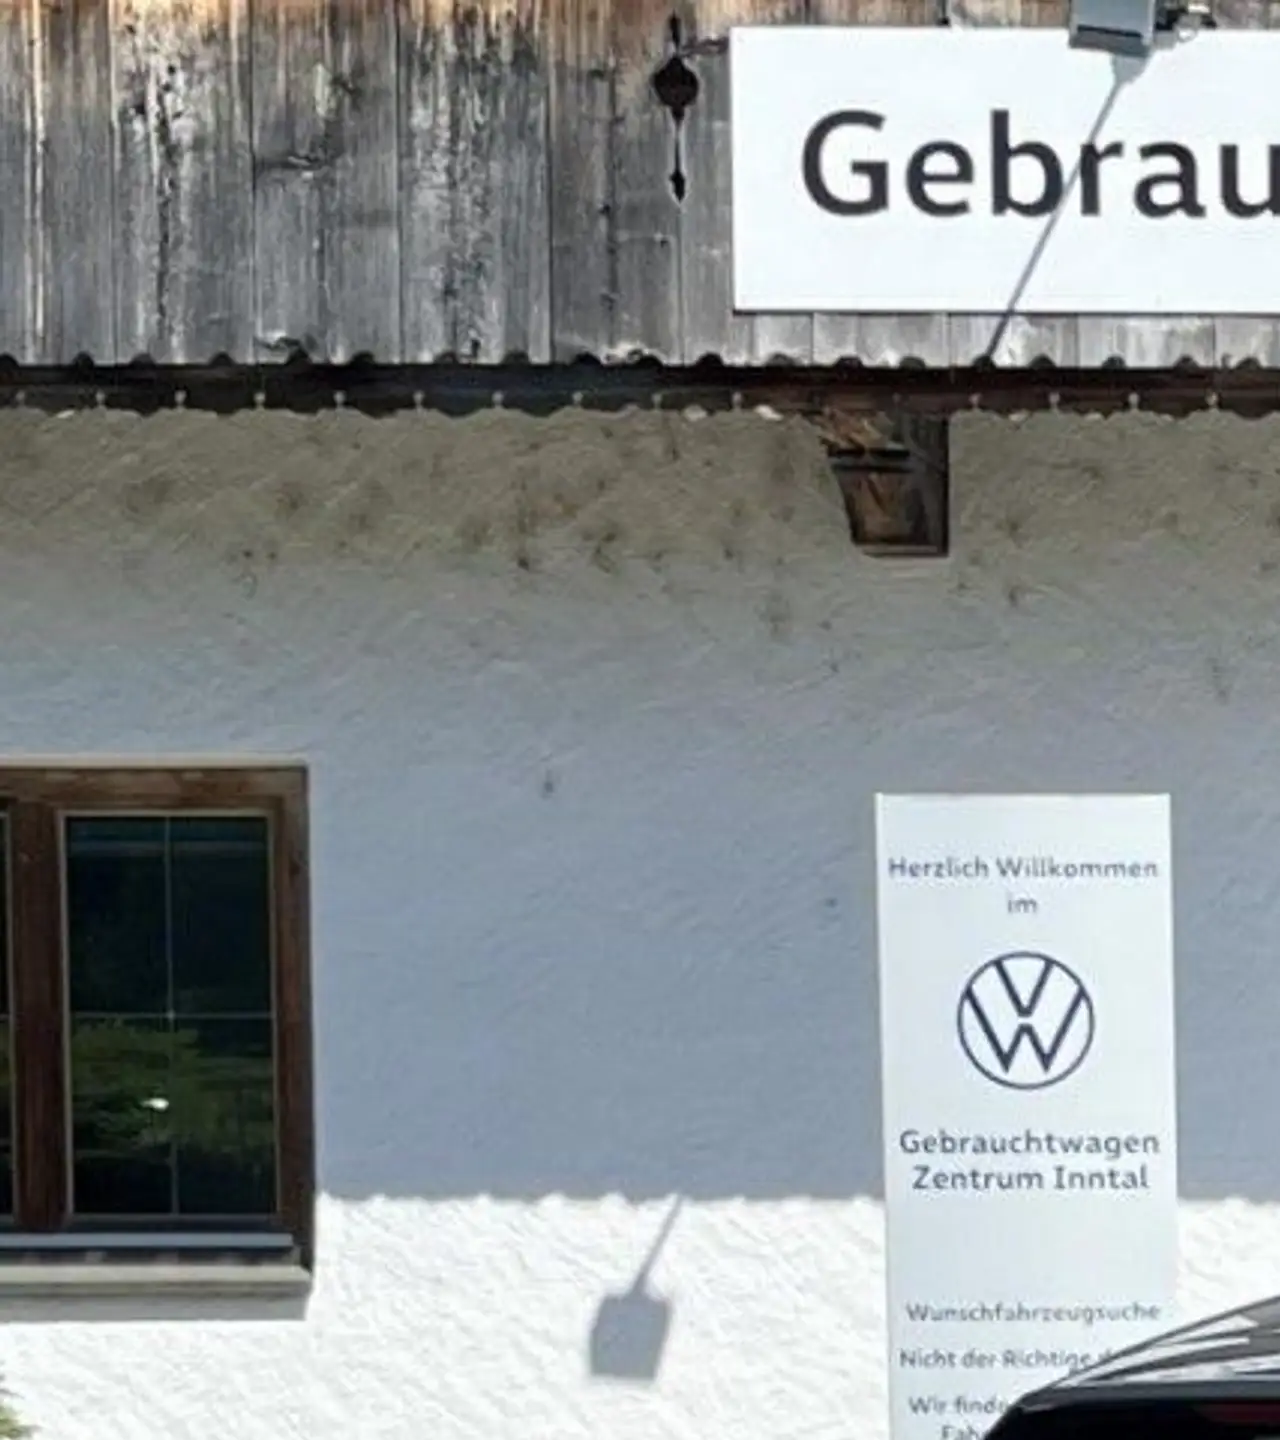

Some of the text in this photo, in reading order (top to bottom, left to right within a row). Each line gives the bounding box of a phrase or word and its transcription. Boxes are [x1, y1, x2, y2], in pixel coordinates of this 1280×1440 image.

[888, 857, 1158, 879] Herzlich Willkommen
[1007, 896, 1038, 914] im
[899, 1129, 1161, 1159] Gebrauchtwagen
[912, 1165, 1149, 1190] Zentrum Inntal
[906, 1303, 1161, 1326] Wunschfahrzeugsuche
[899, 1350, 956, 1368] Nicht
[962, 1350, 998, 1368] der
[908, 1396, 948, 1413] Wir
